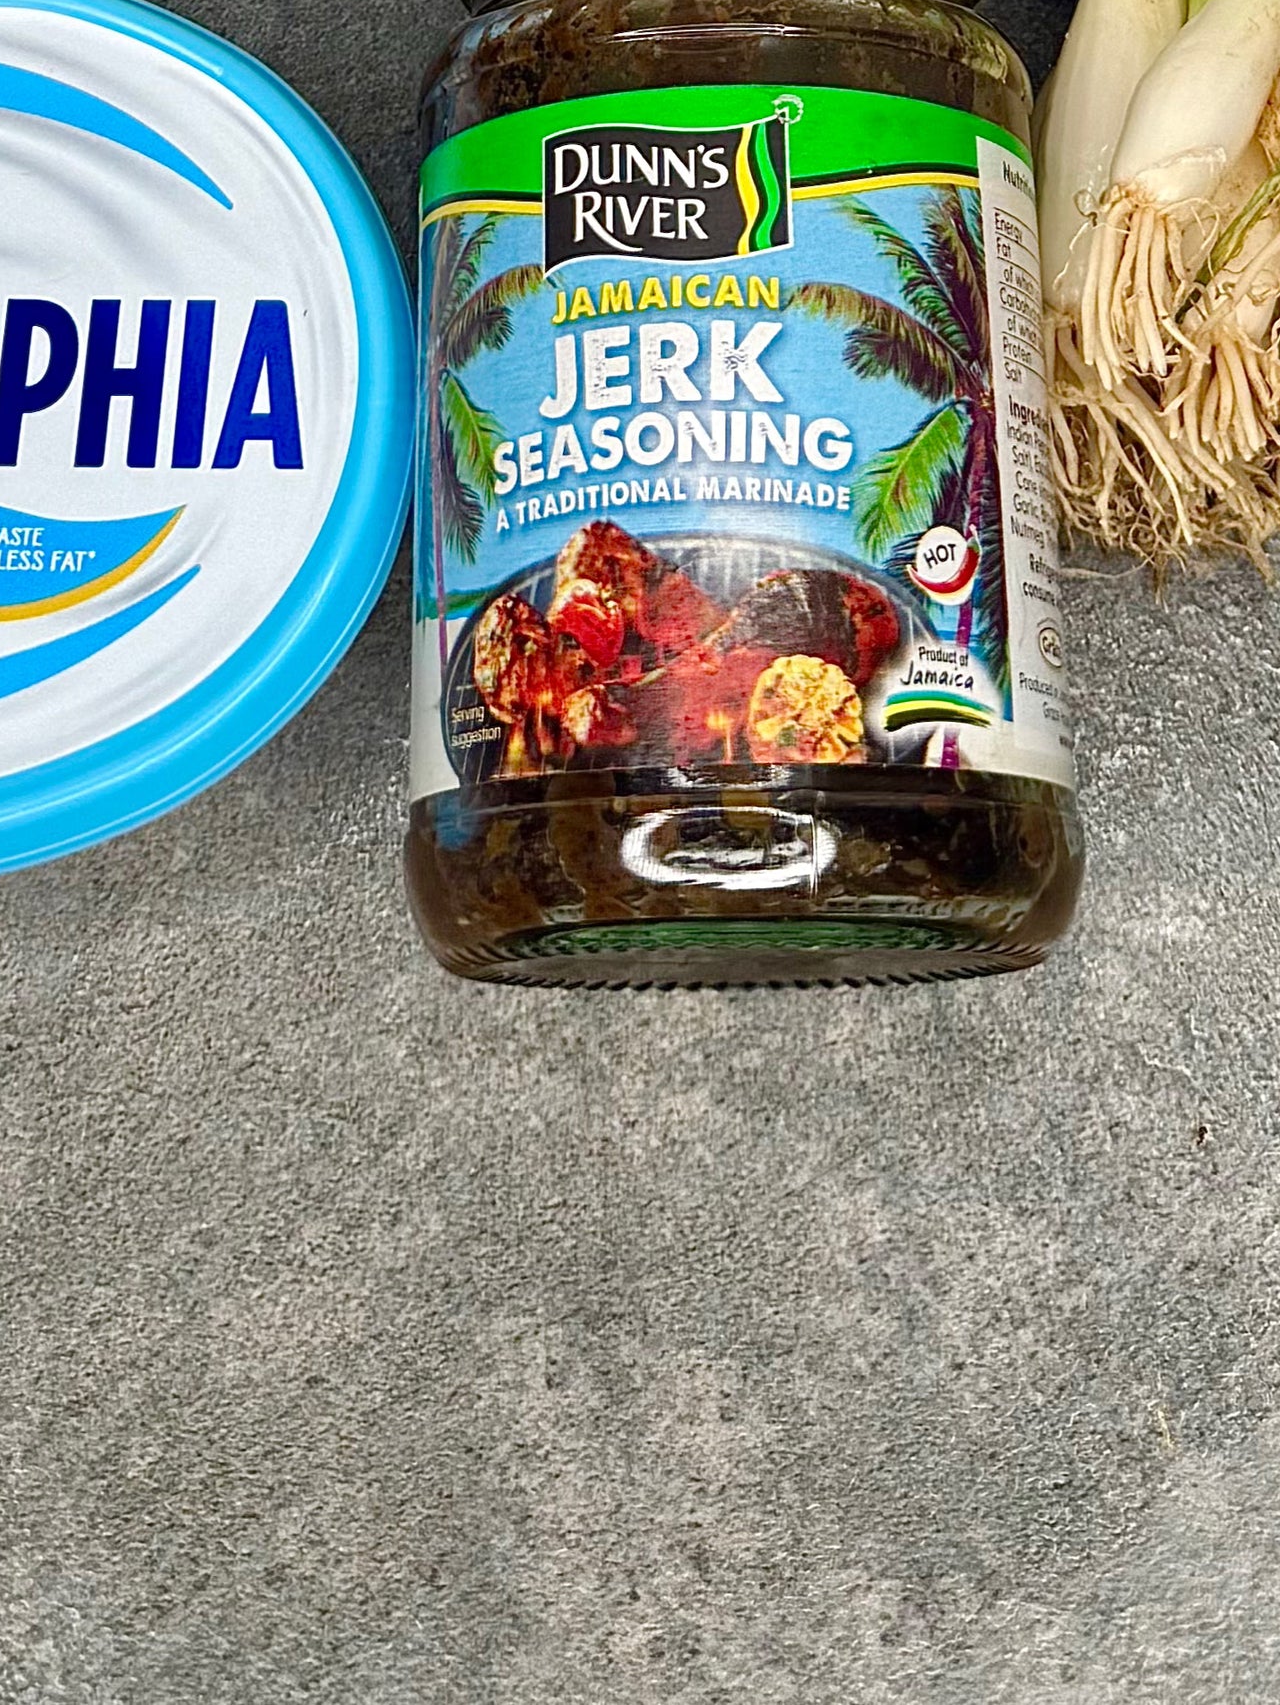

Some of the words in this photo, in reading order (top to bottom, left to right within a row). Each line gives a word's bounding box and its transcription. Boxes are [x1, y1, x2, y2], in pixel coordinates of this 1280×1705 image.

[554, 143, 730, 196] DUNN'S
[573, 192, 709, 253] RIVER
[994, 212, 1024, 244] Energy
[552, 274, 780, 325] JAMAICAN
[1002, 335, 1033, 364] Protein
[539, 320, 784, 419] JERK
[493, 411, 854, 495] SEASONING
[495, 509, 510, 533] A
[515, 477, 687, 528] TRADITIONAL
[697, 476, 852, 511] MARINADE
[923, 543, 957, 570] HOT
[918, 646, 957, 665] Product
[959, 652, 969, 668] of
[900, 660, 974, 690] Jamaica
[451, 706, 485, 723] Serving
[451, 726, 501, 749] suggestion
